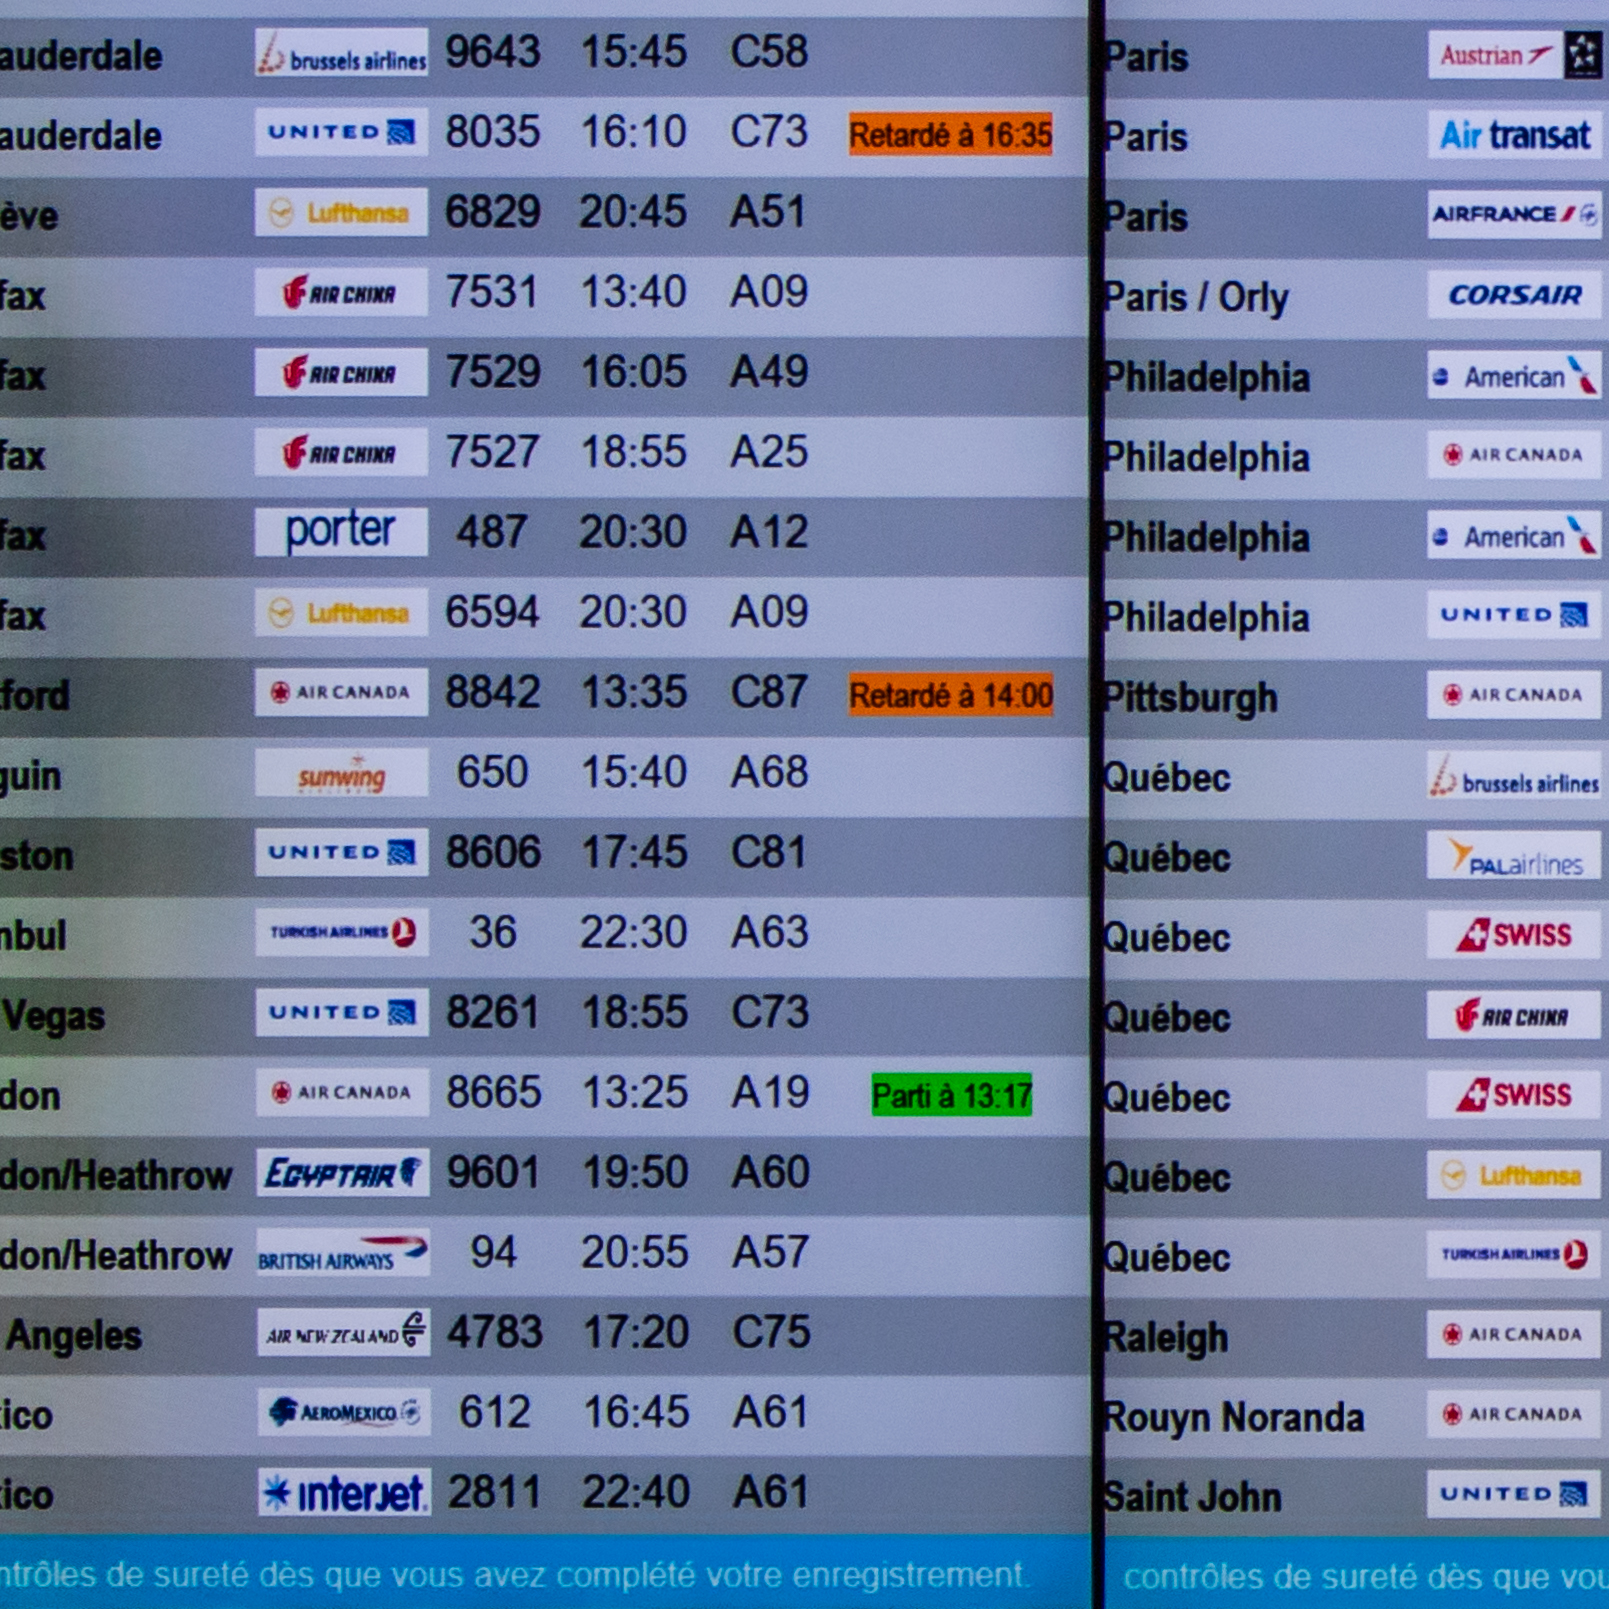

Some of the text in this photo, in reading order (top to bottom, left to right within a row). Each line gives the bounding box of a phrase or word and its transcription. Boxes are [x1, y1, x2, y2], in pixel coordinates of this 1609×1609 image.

[1106, 360, 1311, 399] Philadelphia
[1465, 365, 1565, 388] American
[298, 685, 409, 699] AIR CANADA
[446, 674, 540, 708] 8842
[584, 674, 687, 708] 13:35
[732, 674, 808, 708] C87
[851, 681, 1053, 710] Retardé à 14:00
[1103, 840, 1232, 876] Québec
[258, 1253, 394, 1270] BRITISH AIRWAYS
[472, 1234, 517, 1268] 94
[583, 1234, 689, 1268] 20:55
[733, 1234, 809, 1268] A57
[1105, 1399, 1364, 1440] Rouyn Noranda
[1470, 1407, 1582, 1421] AIR CANADA
[449, 1474, 538, 1508] 2811
[583, 1474, 690, 1508] 22:40
[733, 1474, 805, 1508] A61
[1124, 1561, 1265, 1590] contrôles
[1273, 1562, 1312, 1590] de
[1322, 1562, 1418, 1590] sureté
[1427, 1561, 1483, 1590] dès
[1492, 1568, 1551, 1595] que
